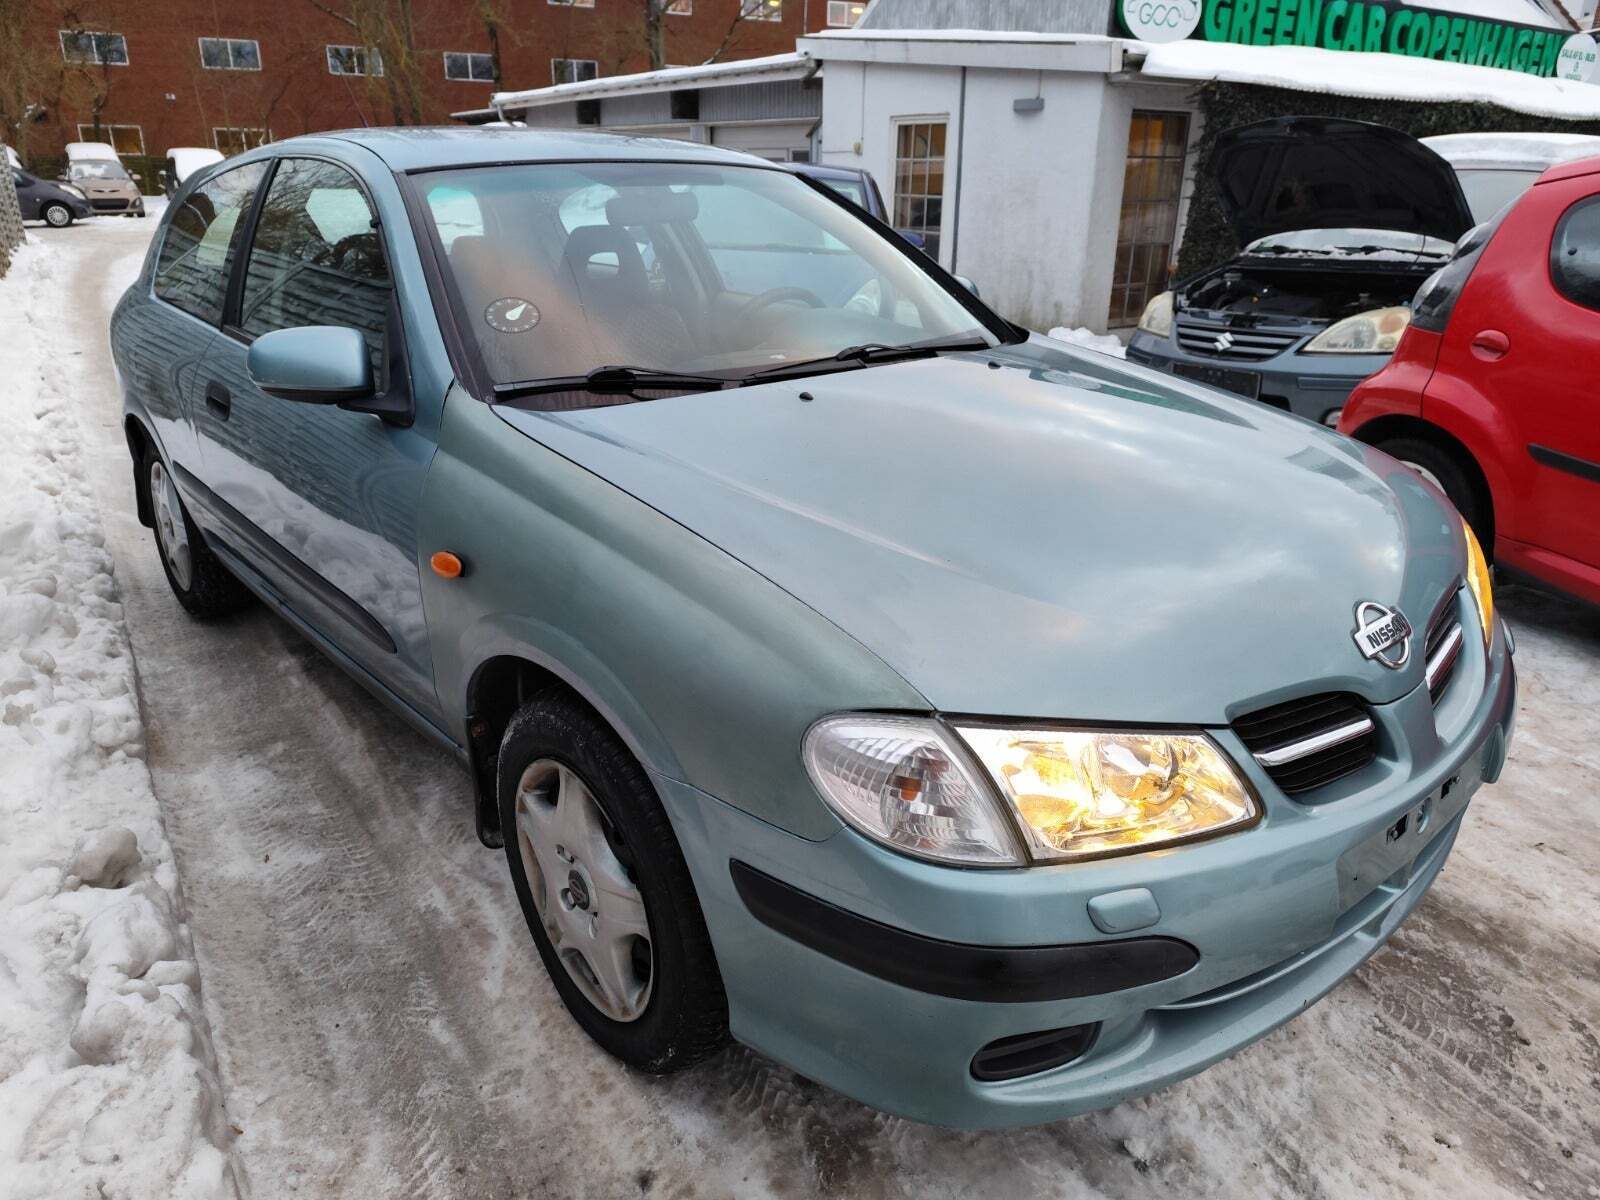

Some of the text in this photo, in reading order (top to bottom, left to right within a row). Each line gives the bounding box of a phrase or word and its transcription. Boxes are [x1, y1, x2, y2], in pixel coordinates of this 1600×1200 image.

[1204, 0, 1565, 78] GREEN CAR COPENHAGEN
[1366, 616, 1406, 649] NISSAN
